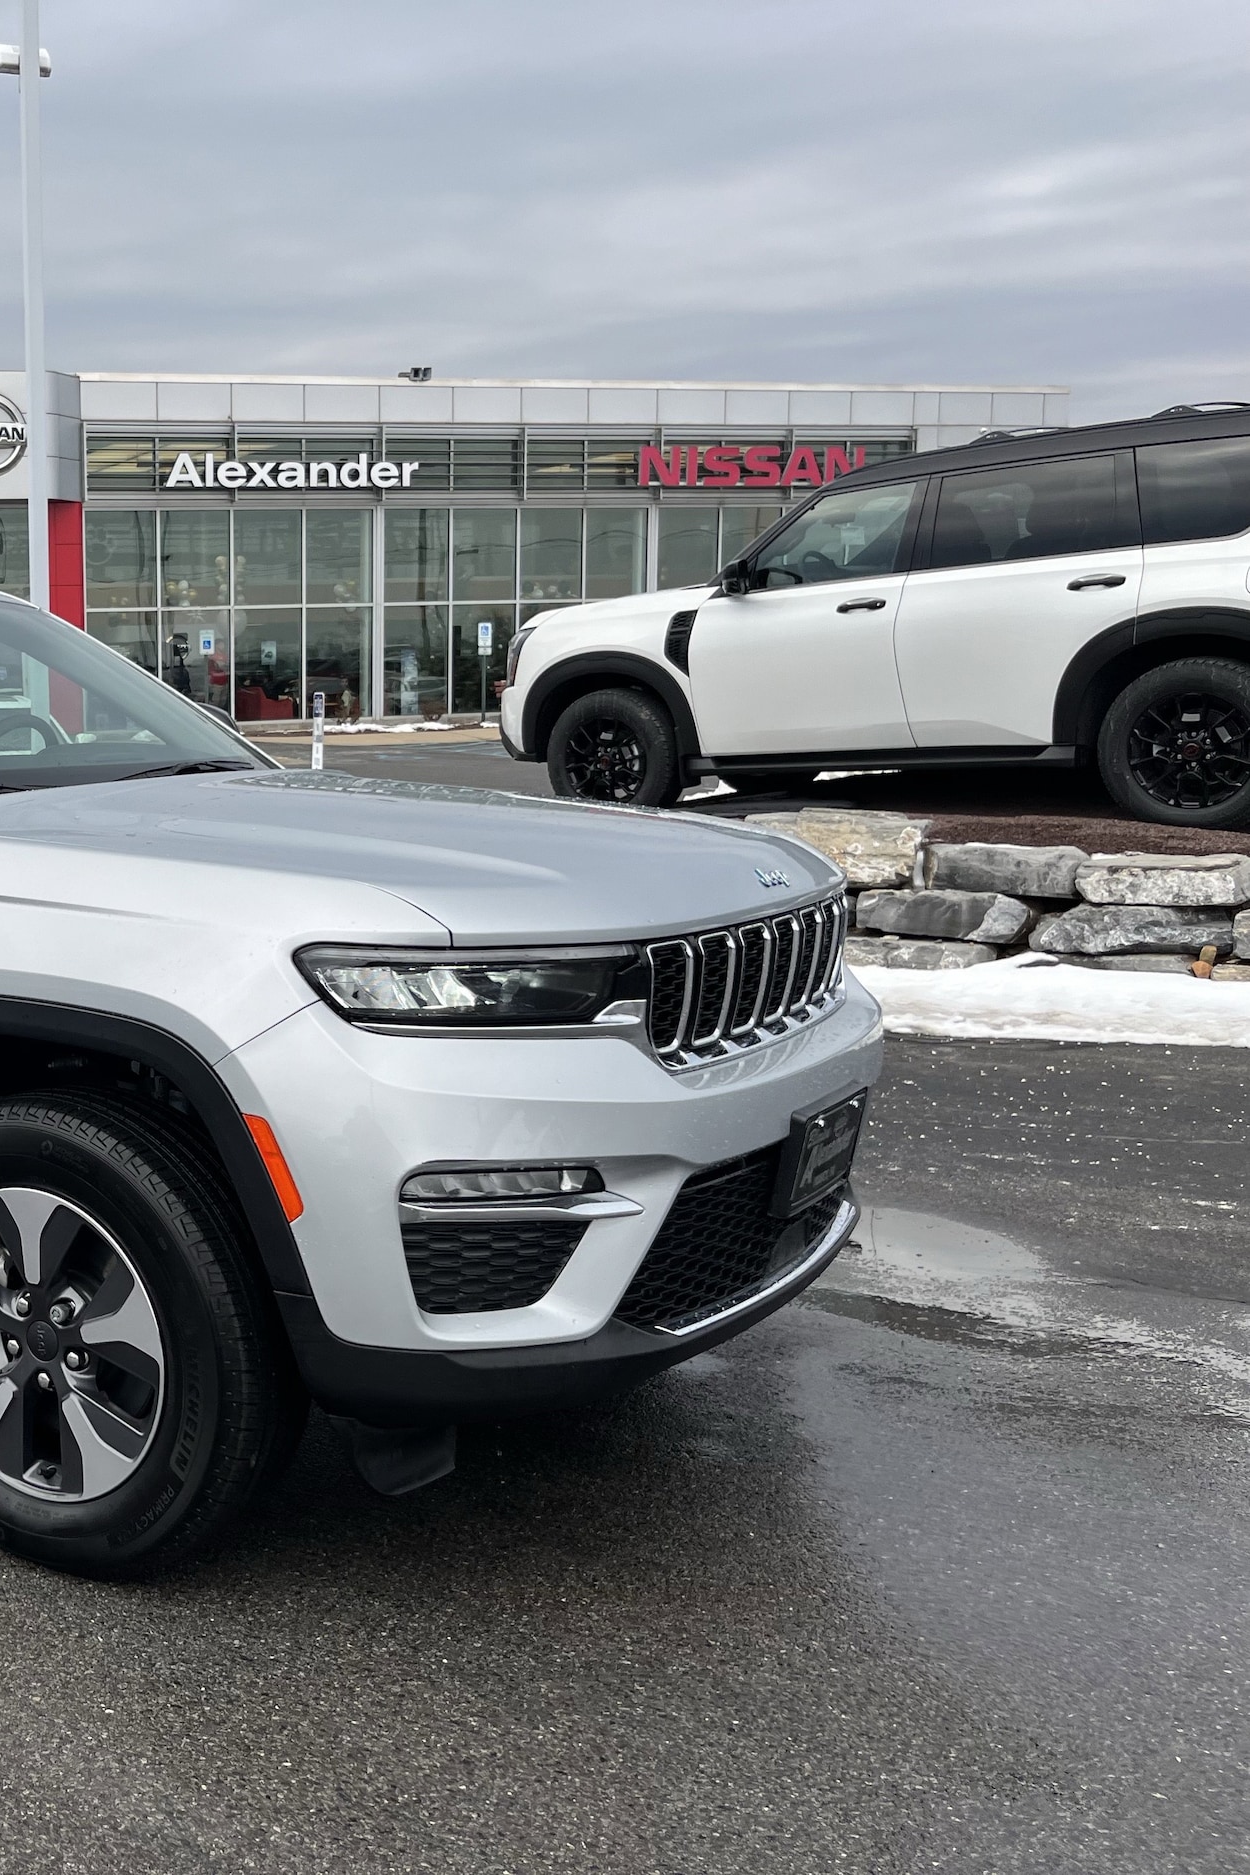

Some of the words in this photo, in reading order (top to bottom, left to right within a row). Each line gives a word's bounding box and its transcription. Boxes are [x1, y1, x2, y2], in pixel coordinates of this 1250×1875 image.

[165, 453, 419, 488] Alexander
[637, 445, 866, 487] NISSAN
[754, 868, 791, 888] Jeep
